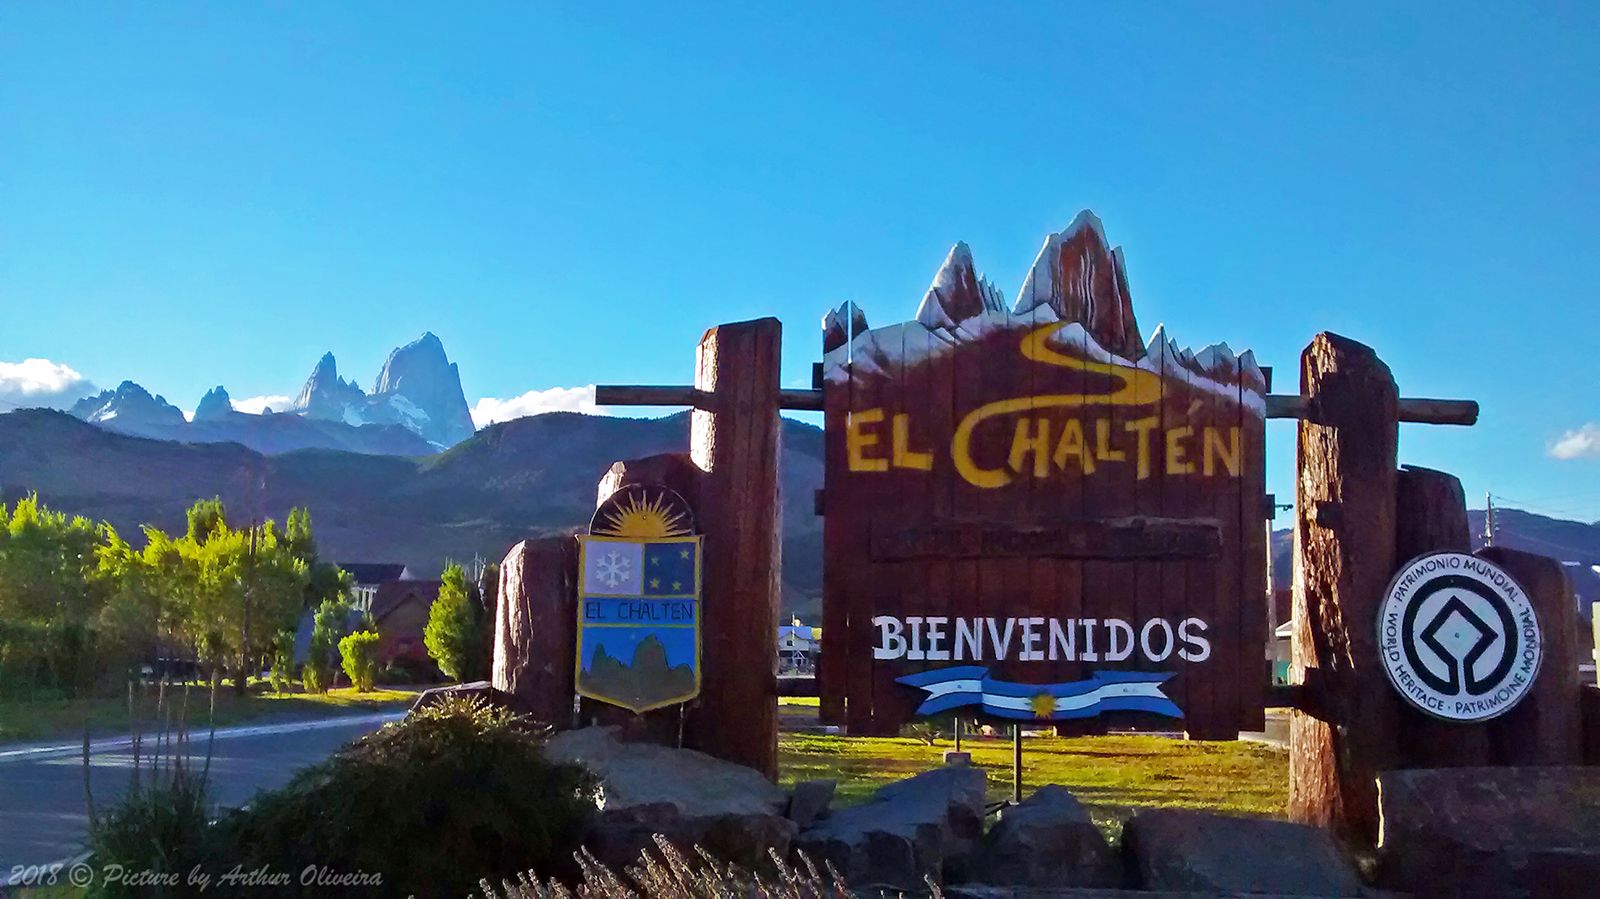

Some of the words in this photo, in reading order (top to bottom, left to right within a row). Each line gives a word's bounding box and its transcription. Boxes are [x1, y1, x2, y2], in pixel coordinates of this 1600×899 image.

[846, 408, 934, 473] EL
[1394, 557, 1460, 602] PATRIMONIO
[1463, 559, 1518, 602] MUNDIAL
[585, 602, 606, 619] EL
[618, 602, 693, 620] CHALTEN
[871, 615, 1212, 663] BIENVENIDOS
[1386, 612, 1400, 662] WORLD
[1395, 665, 1444, 711] HERITAGE
[1455, 672, 1525, 714] PATRIMOINE
[1519, 607, 1537, 674] MONDIAL
